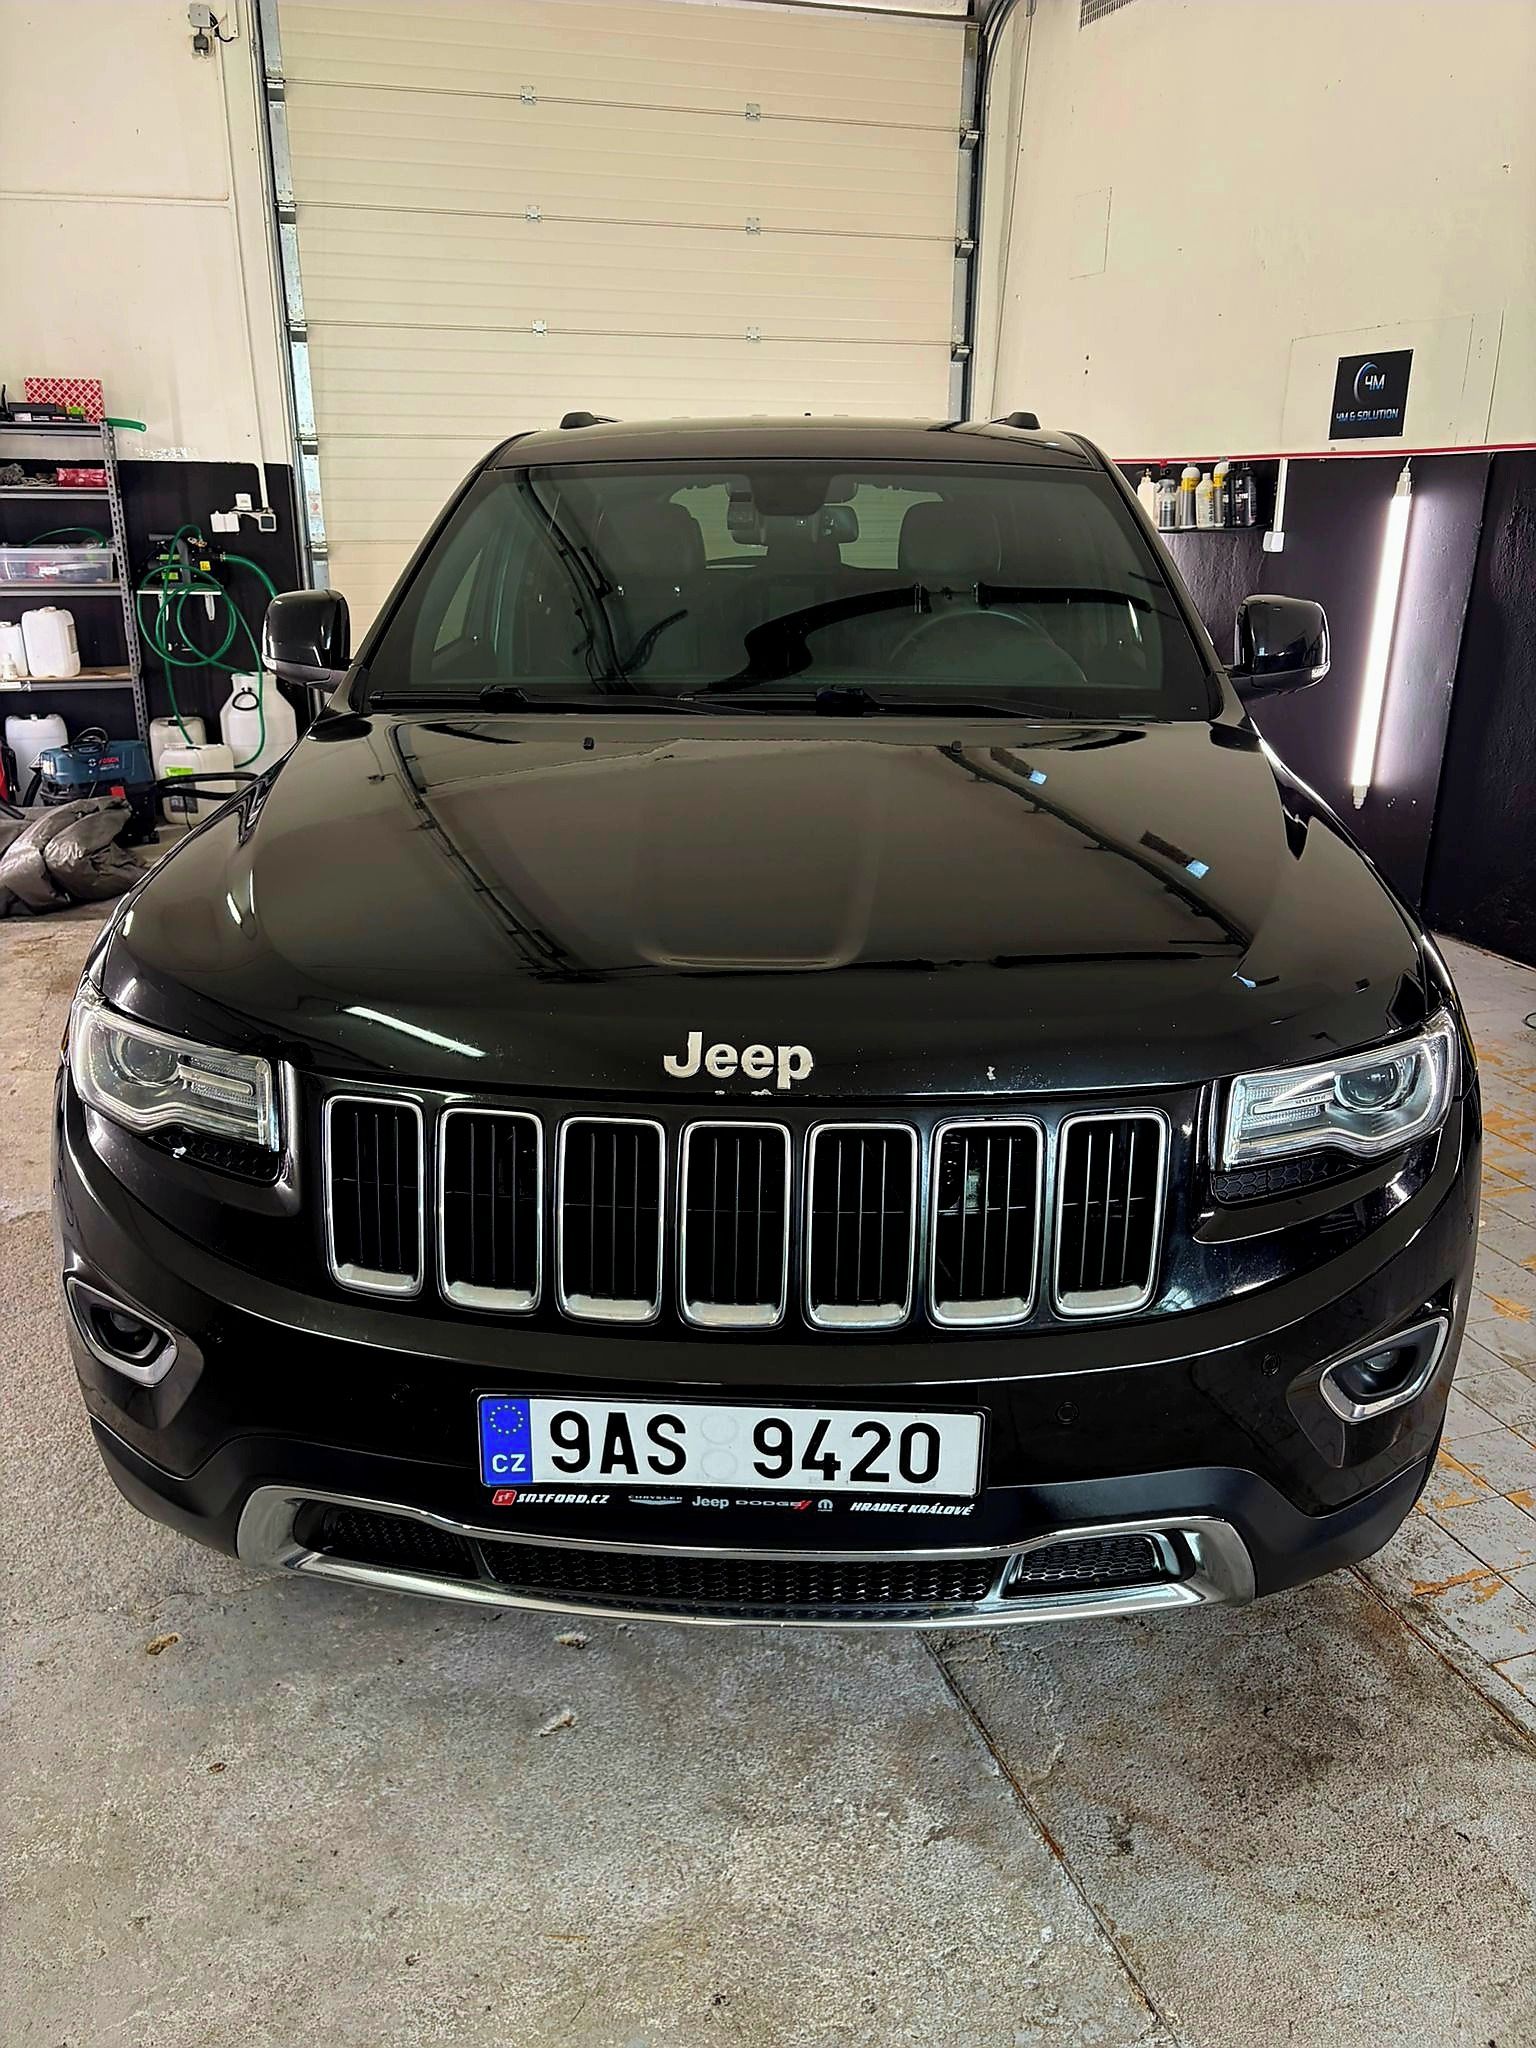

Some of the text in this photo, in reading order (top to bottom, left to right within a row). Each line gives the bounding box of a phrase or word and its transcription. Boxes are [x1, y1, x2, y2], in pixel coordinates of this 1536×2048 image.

[1364, 374, 1385, 391] 4M
[1336, 411, 1349, 422] 4M
[1356, 408, 1399, 421] SOLUTION
[663, 1031, 814, 1090] Jeep
[549, 1410, 941, 1484] 9AS 9420
[491, 1453, 527, 1474] CZ
[692, 1496, 729, 1509] Jeep
[849, 1502, 976, 1516] HRADEC KRÁLOVÉ
